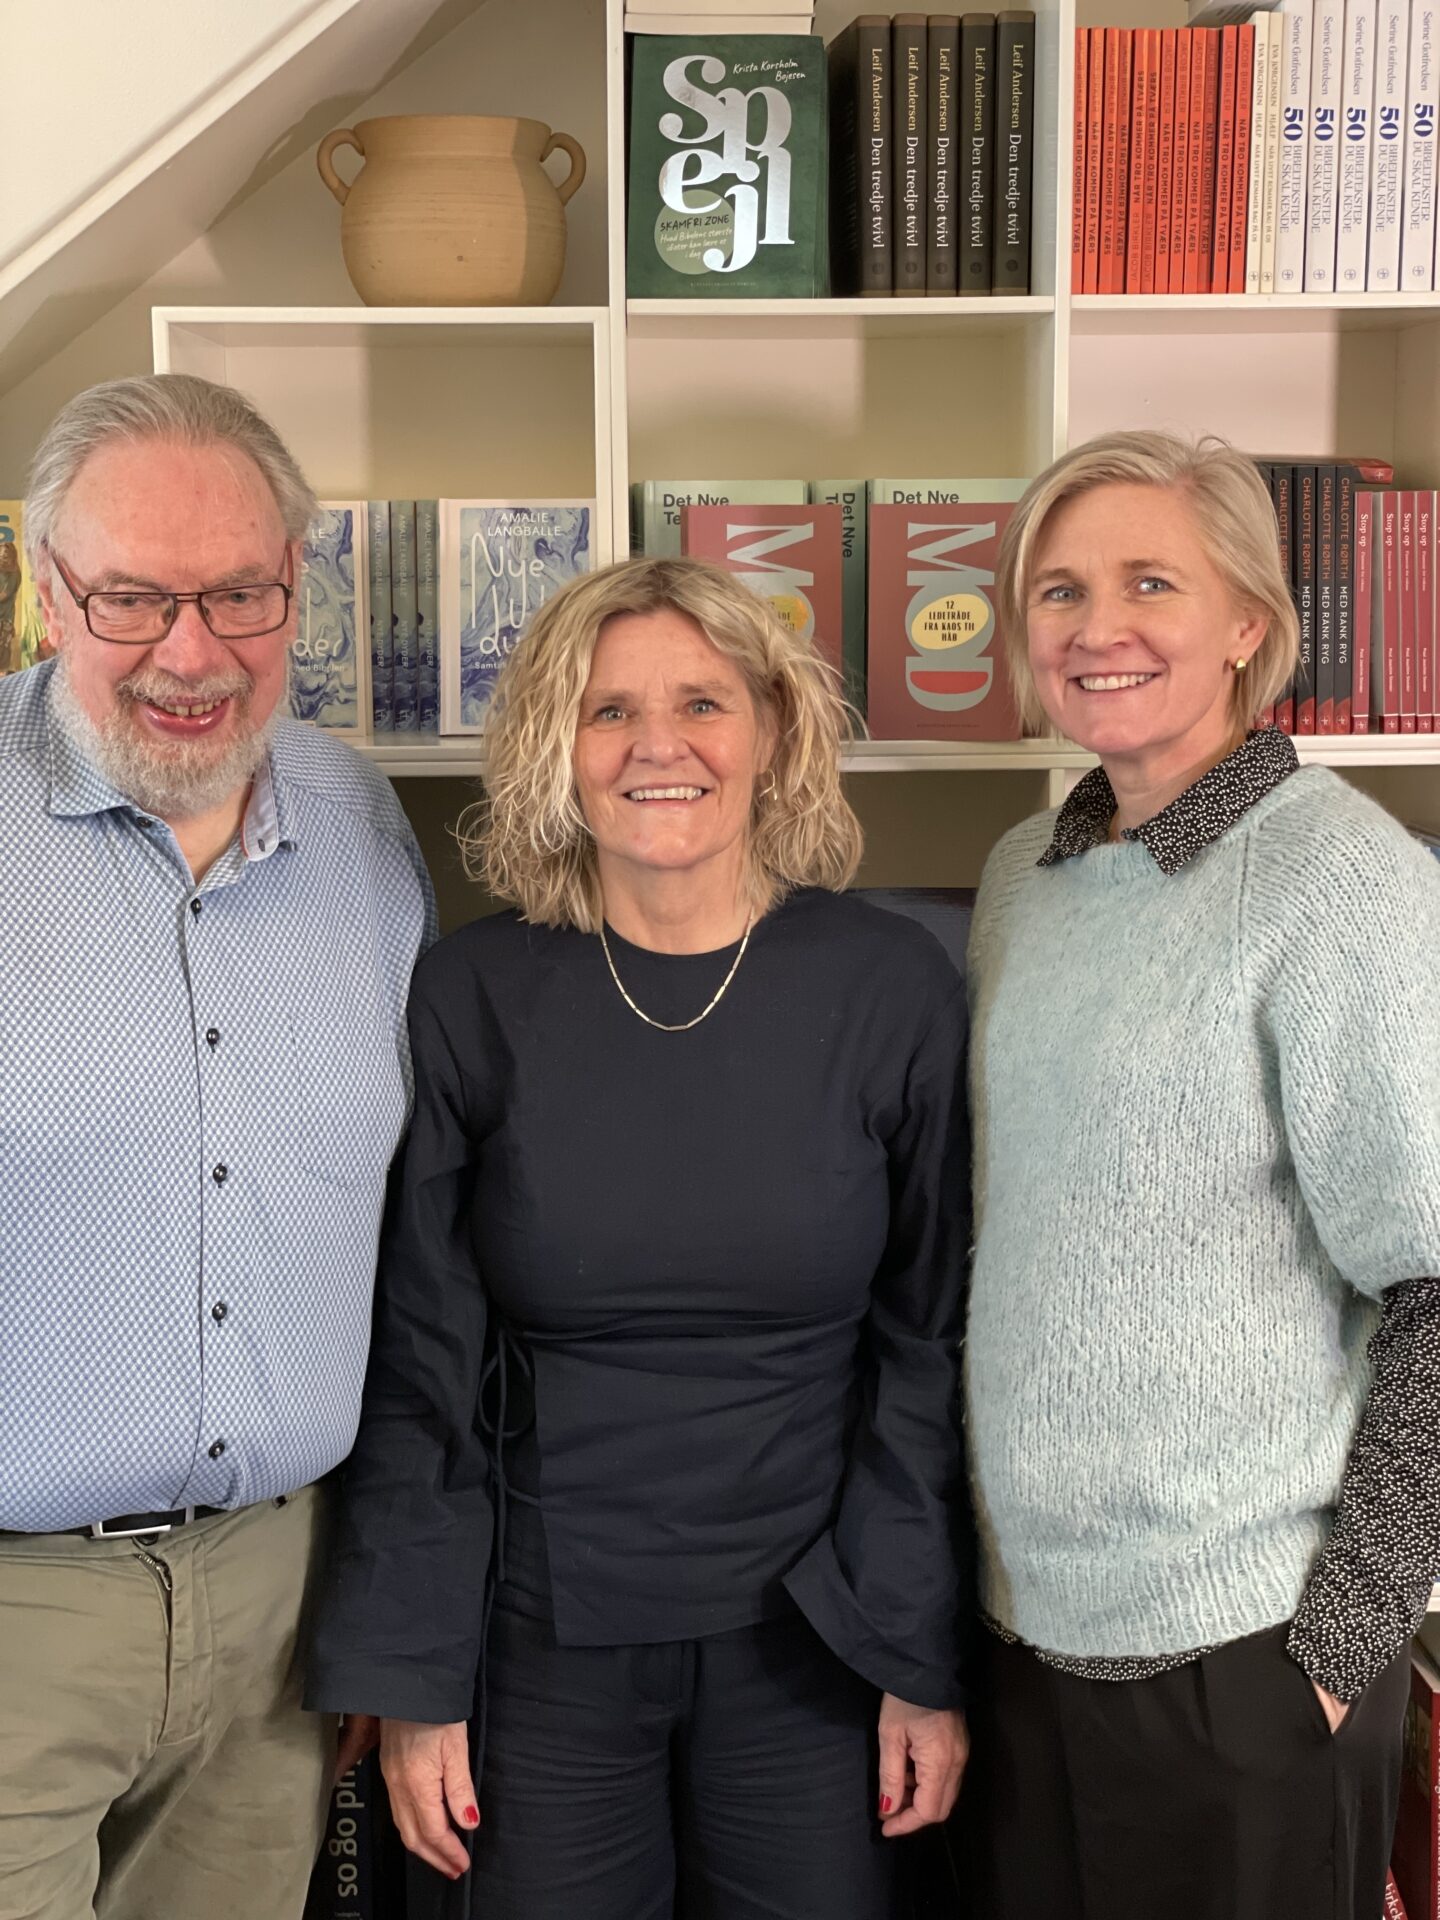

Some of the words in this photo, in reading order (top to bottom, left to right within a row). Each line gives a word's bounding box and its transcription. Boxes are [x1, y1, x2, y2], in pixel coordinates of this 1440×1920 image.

[733, 62, 758, 74] Krista
[761, 58, 798, 71] Korsholm
[872, 48, 883, 72] Leif
[909, 47, 918, 71] Leif
[940, 48, 950, 71] Leif
[975, 48, 985, 71] Leif
[1013, 44, 1024, 68] Leif
[872, 74, 883, 131] Andersen
[909, 73, 918, 130] Andersen
[939, 74, 950, 131] Andersen
[975, 74, 985, 131] Andersen
[1012, 71, 1023, 128] Andersen
[1284, 107, 1303, 141] 50
[1315, 108, 1334, 141] 50
[1346, 108, 1366, 141] 50
[1380, 106, 1399, 140] 50
[1414, 103, 1433, 137] 50
[872, 138, 883, 165] Den
[907, 136, 918, 165] Den
[937, 138, 949, 165] Den
[972, 137, 984, 165] Den
[1009, 134, 1021, 162] Den
[1282, 146, 1292, 160] DU
[1314, 146, 1322, 160] DU
[1345, 146, 1354, 160] DU
[1378, 145, 1388, 159] DU
[1413, 142, 1422, 156] DU
[1006, 167, 1020, 209] tredje
[1220, 164, 1228, 203] KOMMER
[1236, 163, 1244, 201] KOMMER
[1282, 164, 1291, 192] SKAL
[1291, 145, 1302, 224] BIBELTEKSTER
[1312, 164, 1322, 192] SKAL
[1322, 146, 1333, 224] BIBELTEKSTER
[1344, 164, 1353, 192] SKAL
[1353, 146, 1365, 224] BIBELTEKSTER
[1377, 163, 1386, 191] SKAL
[1386, 145, 1398, 224] BIBELTEKSTER
[1412, 160, 1421, 188] SKAL
[1421, 141, 1432, 221] BIBELTEKSTER
[869, 171, 884, 212] tredje
[904, 169, 918, 211] tredje
[934, 170, 949, 211] tredje
[969, 170, 983, 211] tredje
[660, 217, 702, 232] SKAMFRI
[704, 214, 730, 226] ZONE
[1280, 196, 1290, 233] KENDE
[1311, 196, 1321, 233] KENDE
[1343, 196, 1352, 233] KENDE
[1376, 195, 1385, 232] KENDE
[1410, 192, 1420, 230] KENDE
[872, 217, 884, 248] tvivl
[907, 216, 918, 247] tvivl
[937, 216, 948, 247] tvivl
[972, 216, 983, 247] tvivl
[1008, 214, 1019, 244] tvivl
[663, 493, 692, 507] Det
[842, 493, 855, 521] Det
[893, 490, 922, 504] Det
[1280, 479, 1288, 540] CHARLOTTE
[1303, 478, 1311, 539] CHARLOTTE
[1323, 478, 1331, 539] CHARLOTTE
[1341, 478, 1349, 539] CHARLOTTE
[487, 526, 561, 537] LANGBALLE
[500, 512, 549, 523] AMALIE
[1359, 514, 1368, 533] Stop
[1385, 513, 1394, 533] Stop
[1403, 513, 1411, 533] Stop
[1420, 513, 1428, 533] Stop
[1358, 536, 1366, 547] op
[1385, 535, 1392, 546] op
[1403, 535, 1409, 546] op
[1420, 535, 1426, 546] op
[1303, 544, 1311, 578] RØRTH
[1341, 544, 1349, 578] RØRTH
[945, 600, 955, 610] 12
[1322, 587, 1330, 608] MED
[1340, 586, 1348, 608] MED
[924, 622, 939, 631] FRA
[941, 622, 962, 631] KAOS
[929, 611, 971, 620] LEDETRÅDE
[1322, 612, 1330, 639] RANK
[941, 632, 958, 642] HÅB
[1302, 643, 1310, 664] RYG
[1339, 643, 1347, 664] RYG
[328, 1817, 359, 1857] og
[337, 1862, 360, 1898] os
